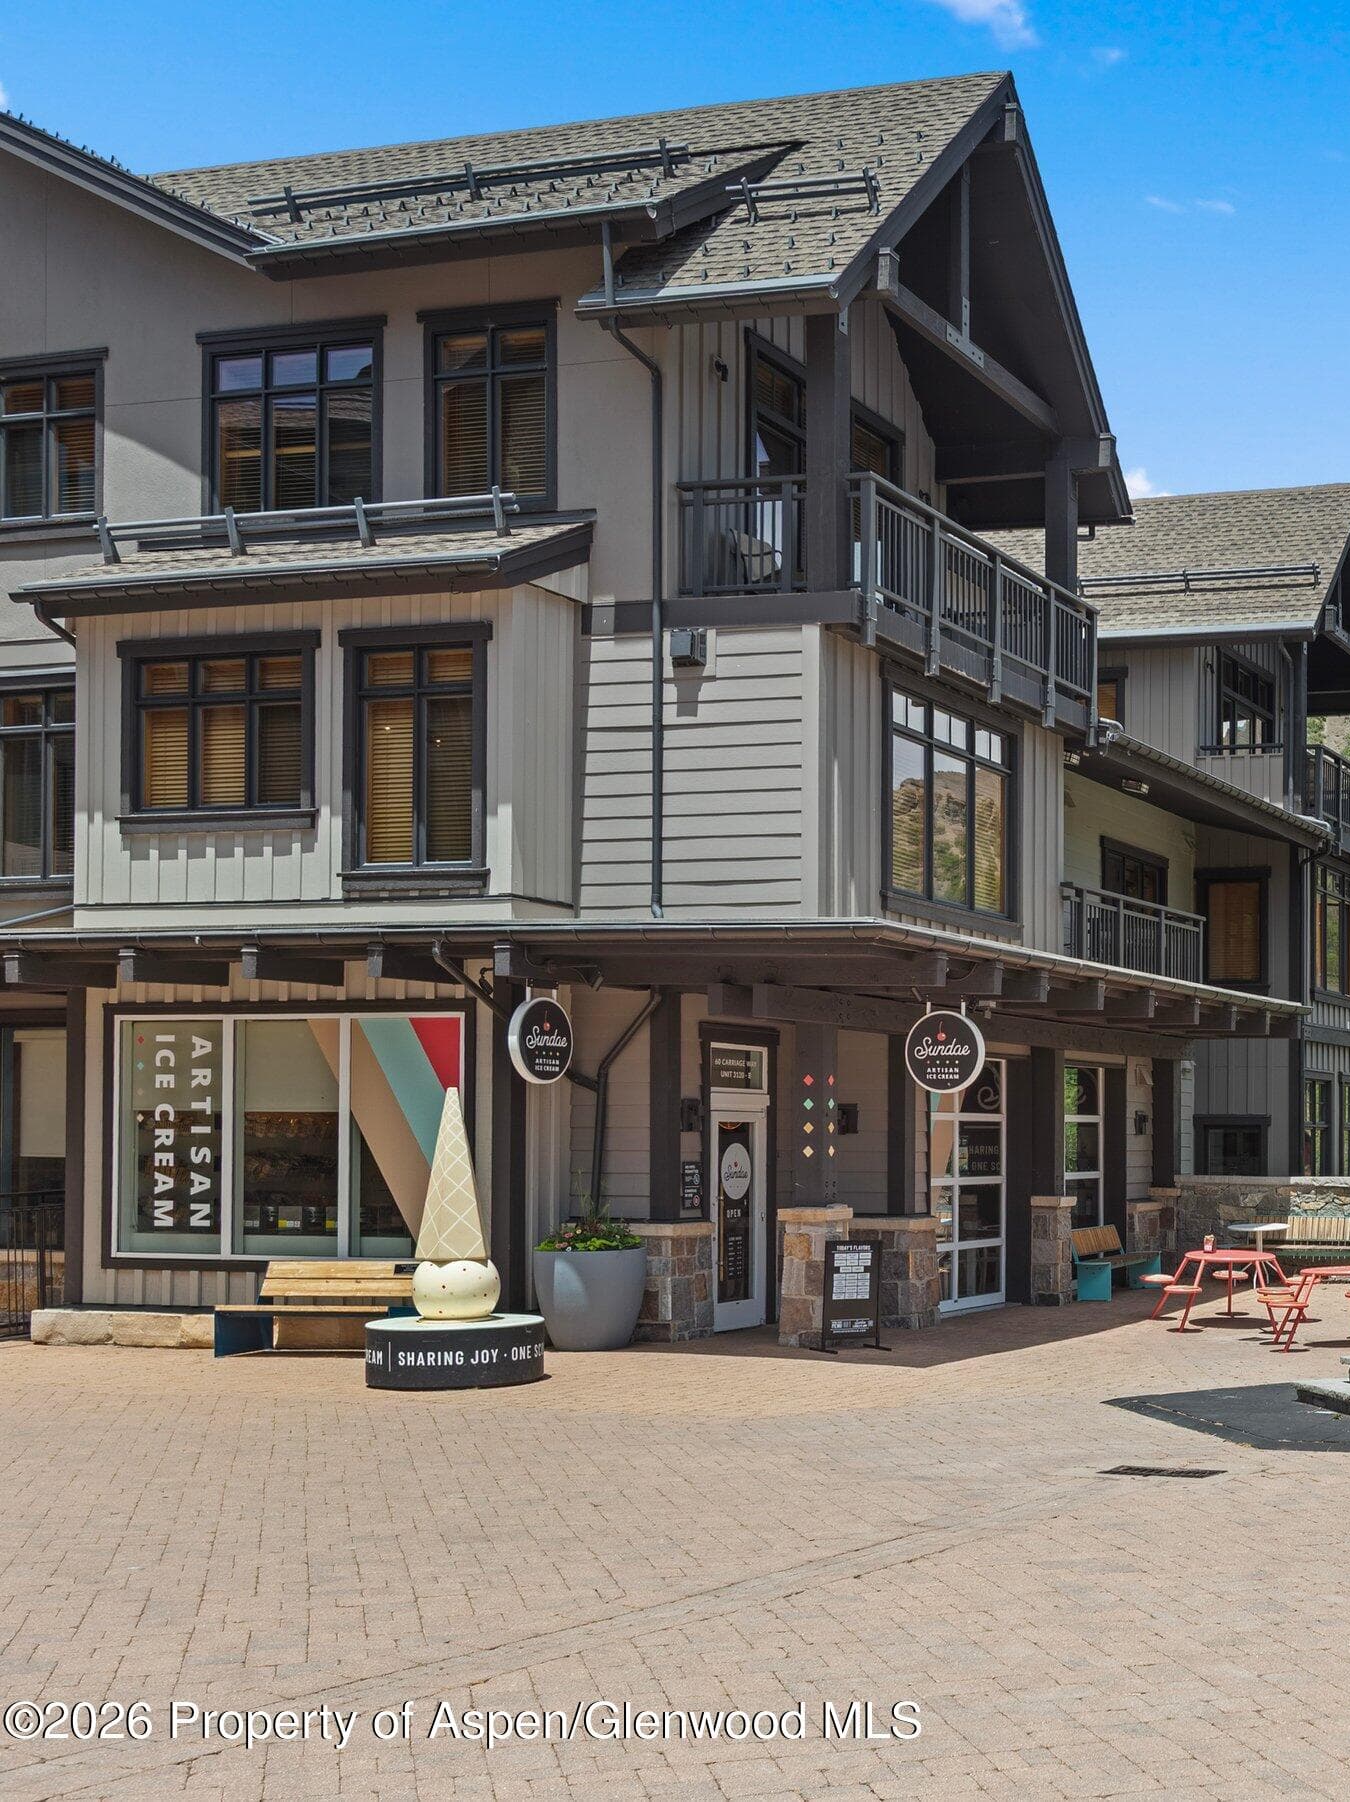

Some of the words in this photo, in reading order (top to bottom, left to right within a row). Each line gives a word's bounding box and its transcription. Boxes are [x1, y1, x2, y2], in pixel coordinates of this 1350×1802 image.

[526, 1025, 568, 1049] Sundae
[914, 1036, 971, 1059] Sundae
[154, 1034, 176, 1089] ICE
[722, 1059, 746, 1067] CARRIAGE
[720, 1070, 733, 1078] UNIT
[190, 1035, 213, 1227] ARTISAN
[967, 1145, 1000, 1155] HARING
[153, 1103, 175, 1227] CREAM
[726, 1209, 741, 1218] OPEN
[365, 1348, 383, 1366] REAM
[398, 1350, 465, 1367] SHARING
[470, 1348, 499, 1365] JOY
[511, 1344, 532, 1361] ONE
